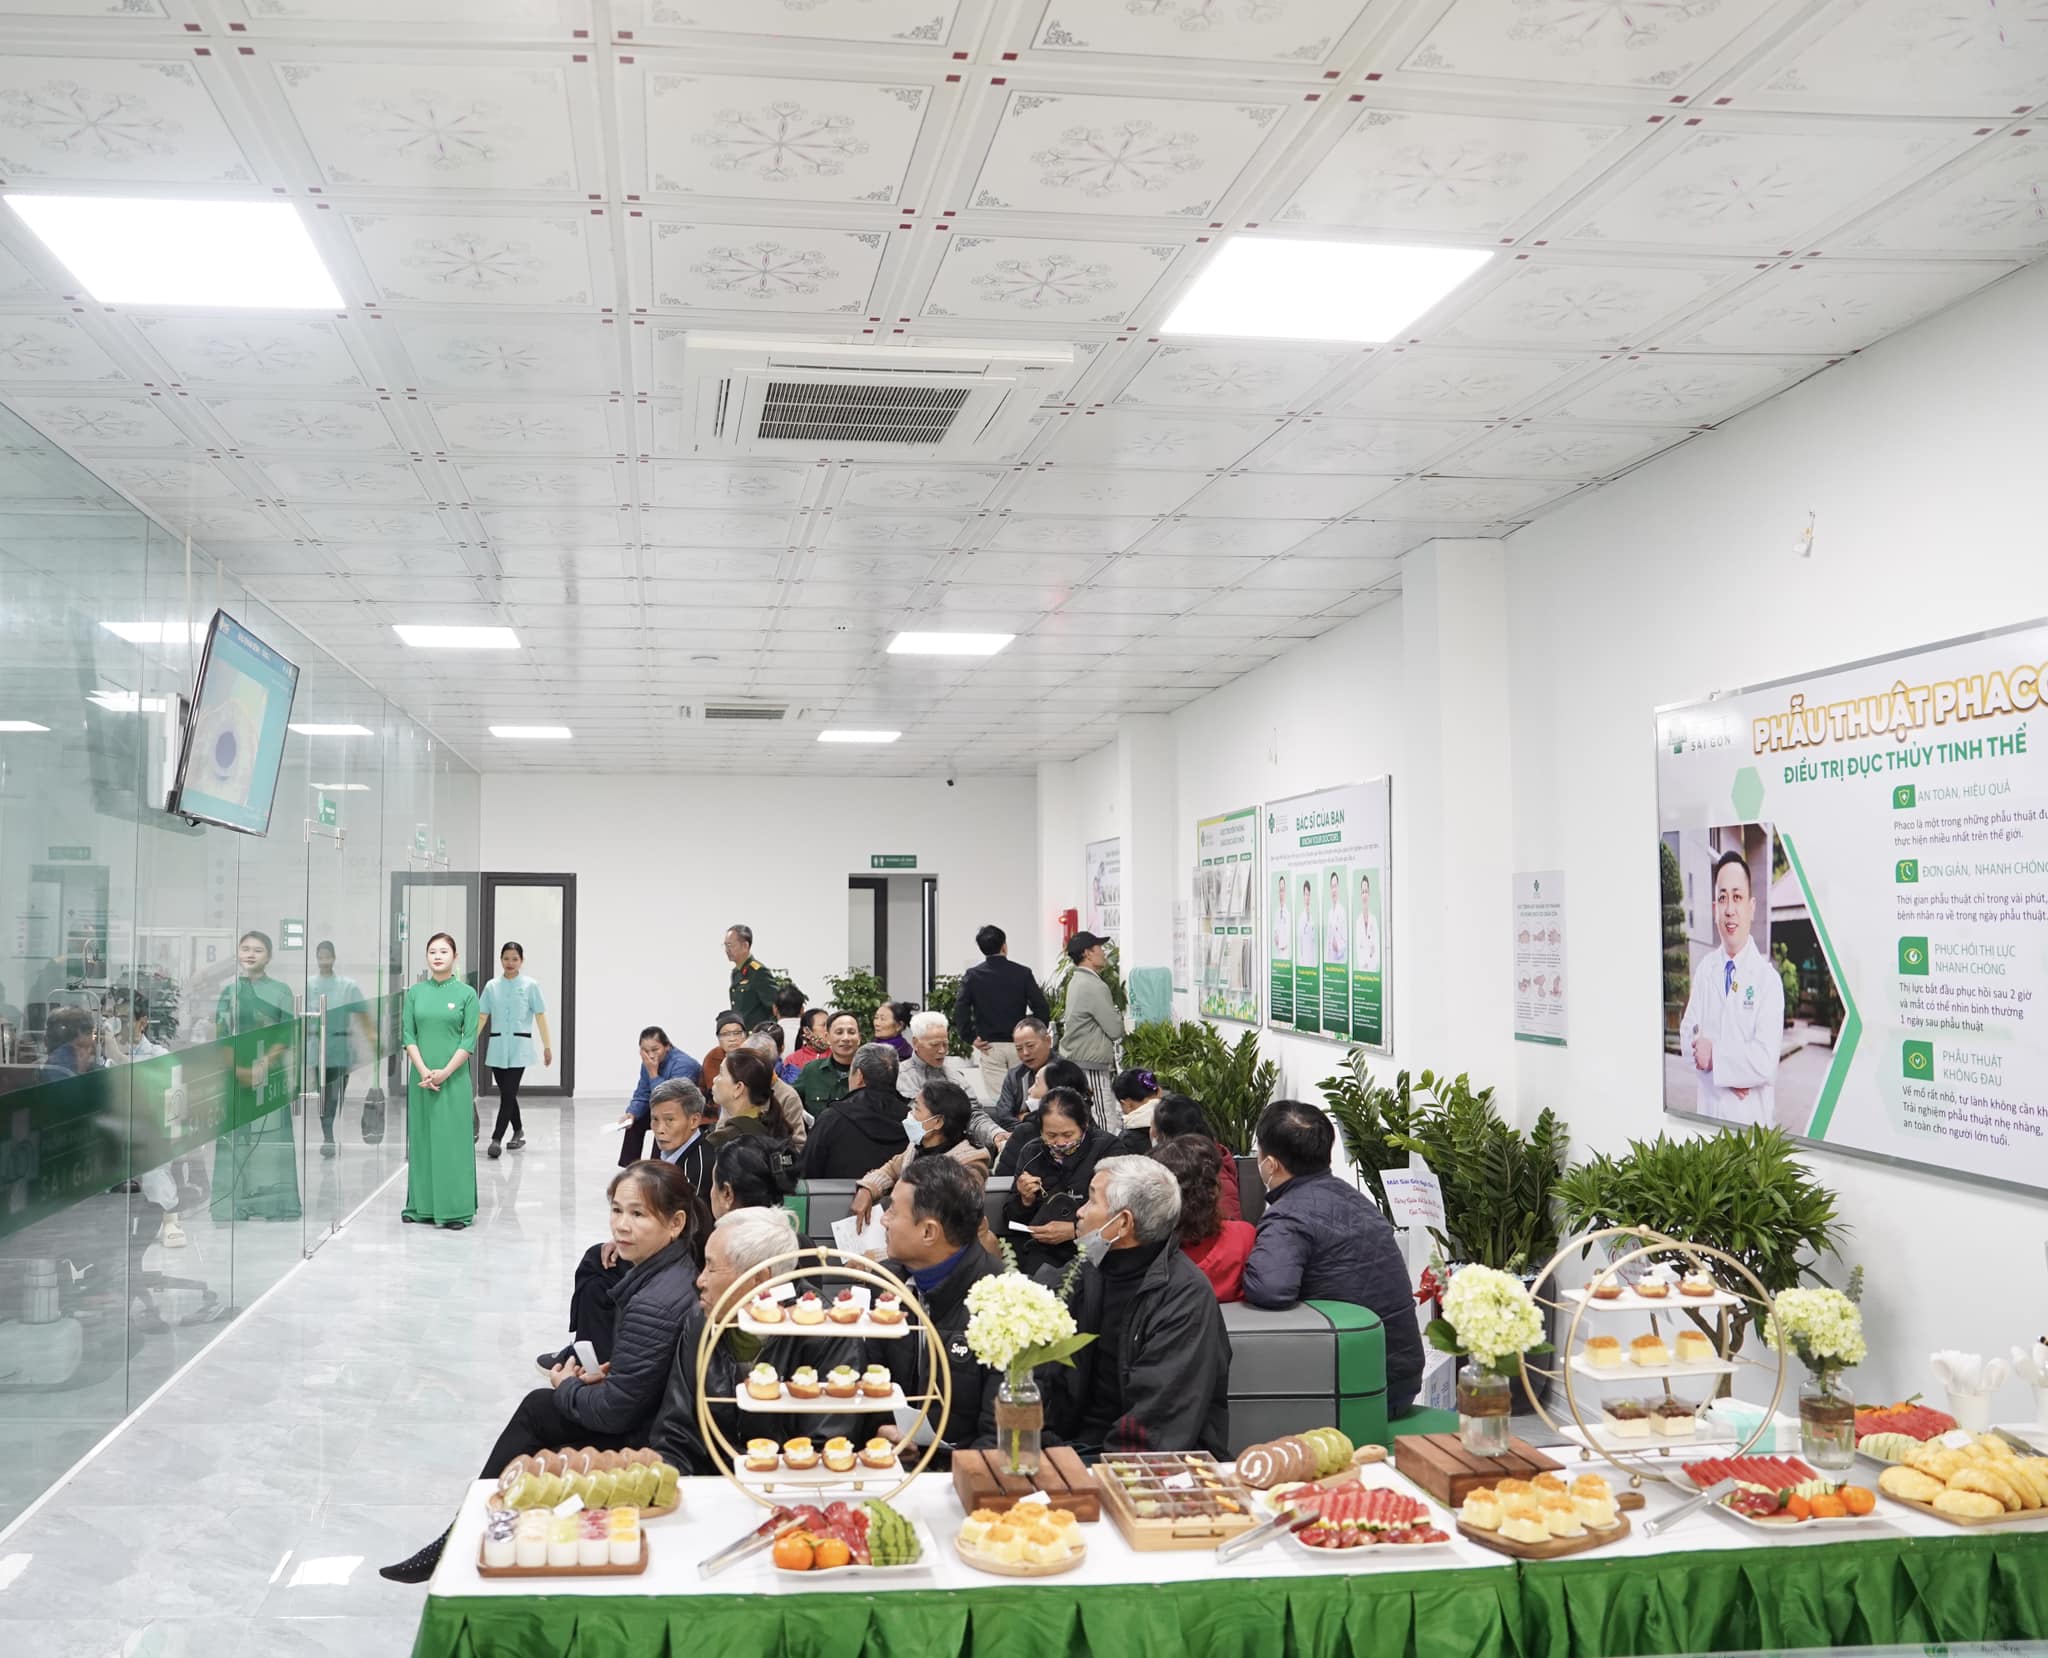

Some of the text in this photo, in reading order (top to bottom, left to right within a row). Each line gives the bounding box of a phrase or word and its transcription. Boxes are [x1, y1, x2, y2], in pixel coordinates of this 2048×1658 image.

[1753, 693, 1827, 755] PHẪU
[1828, 680, 1930, 743] THUẬT
[1784, 722, 2027, 784] ĐIỀU TRỊ ĐỤC THỦY TINH THỂ
[1894, 820, 1915, 831] Phaco
[1924, 818, 1940, 829] một
[1941, 818, 1962, 828] trong
[1963, 814, 1989, 827] những
[1990, 810, 2012, 825] phẫu
[2013, 810, 2036, 822] thuật
[1929, 832, 1950, 844] nhiều
[1952, 830, 1970, 842] nhất
[1971, 831, 1988, 841] trên
[1975, 863, 2012, 874] NHANH
[1913, 895, 1928, 907] gian
[1930, 892, 1949, 906] phẫu
[1951, 893, 1971, 904] thuật
[1973, 893, 1985, 904] chỉ
[1987, 893, 2009, 906] trong
[2011, 892, 2023, 903] vài
[1897, 910, 1915, 921] bệnh
[1916, 910, 1934, 920] nhân
[1936, 912, 1944, 920] ra
[1945, 910, 1954, 920] về
[1956, 911, 1977, 922] trong
[1979, 911, 1998, 923] ngày
[2000, 907, 2021, 923] phẫu
[1935, 960, 2006, 976] NHANH CHÓNG
[1899, 982, 1911, 994] Thị
[1925, 982, 1938, 995] bắt
[1940, 983, 1954, 995] đầu
[1956, 985, 1976, 998] phục
[1978, 986, 1991, 998] hồi
[1993, 989, 2008, 999] sau
[2010, 988, 2016, 999] 2
[2017, 991, 2032, 1003] giờ
[1899, 1000, 1908, 1009] và
[1910, 999, 1925, 1009] mắt
[1926, 1000, 1935, 1010] có
[1936, 1000, 1950, 1012] thể
[1971, 1003, 1989, 1015] bình
[1991, 1006, 2024, 1020] thường
[1901, 1014, 1984, 1033] 1 ngày sau phẫu thuật
[1943, 1067, 2002, 1087] KHÔNG ĐAU
[1927, 1087, 1938, 1100] rất
[1970, 1095, 1988, 1108] lành
[1990, 1098, 2018, 1116] không
[2020, 1101, 2035, 1115] cần
[1902, 1101, 2044, 1137] Trải nghiệm phẫu thuật nhẹ nhàng,
[1903, 1119, 2010, 1146] an toàn cho người lớn tuổi.
[951, 1342, 969, 1357] Sup
